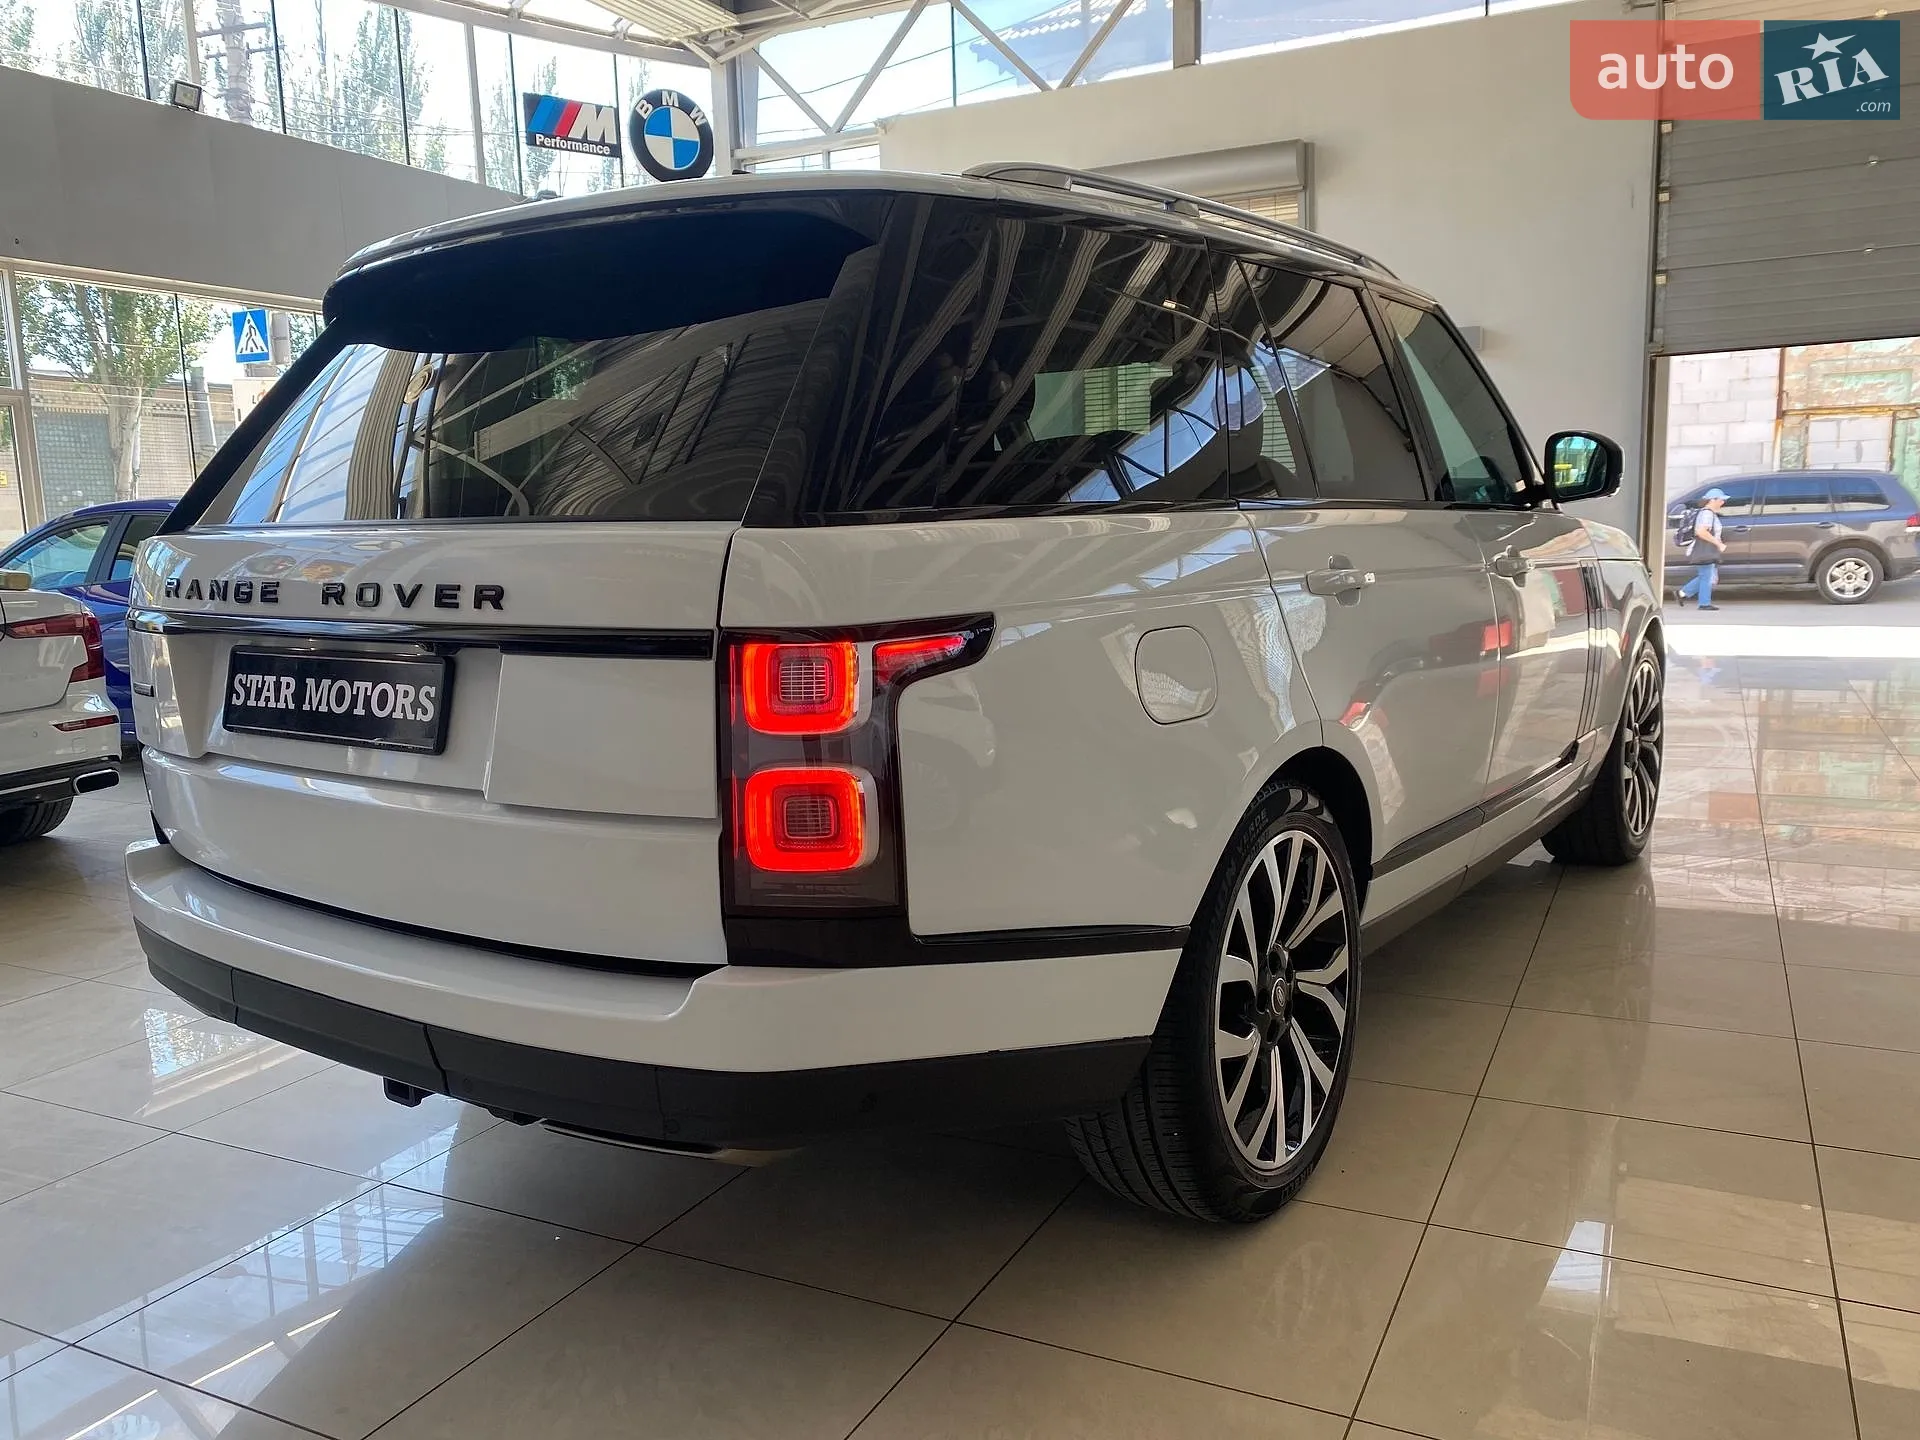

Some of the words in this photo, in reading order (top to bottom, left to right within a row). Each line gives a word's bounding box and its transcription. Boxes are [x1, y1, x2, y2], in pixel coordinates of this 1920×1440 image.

[567, 103, 617, 145] M
[635, 90, 708, 127] BMW
[535, 133, 611, 155] Performance
[163, 577, 281, 604] RANGE
[321, 581, 505, 611] ROVER
[231, 672, 295, 710] STAR
[302, 677, 436, 722] MOTORS
